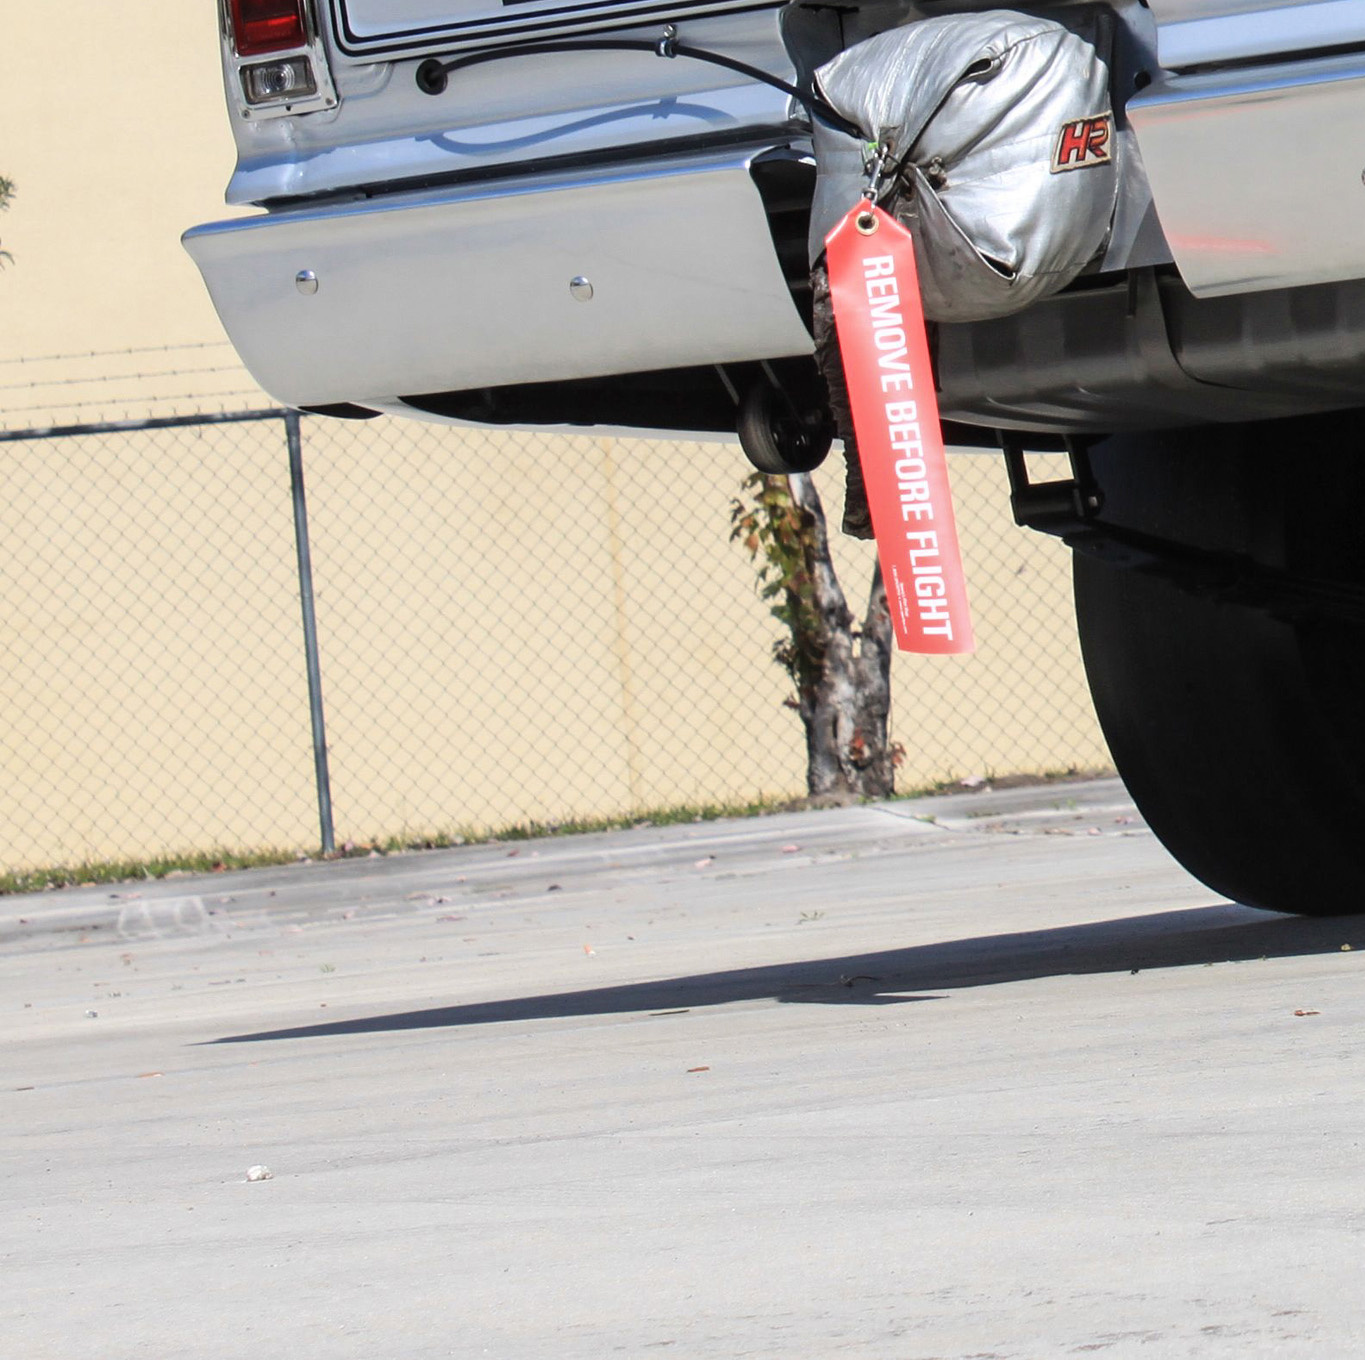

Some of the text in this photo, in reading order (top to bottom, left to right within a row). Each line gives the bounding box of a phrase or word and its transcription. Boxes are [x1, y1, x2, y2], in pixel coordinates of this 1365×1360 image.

[862, 255, 954, 642] REMOVE BEFORE FLIGHT
